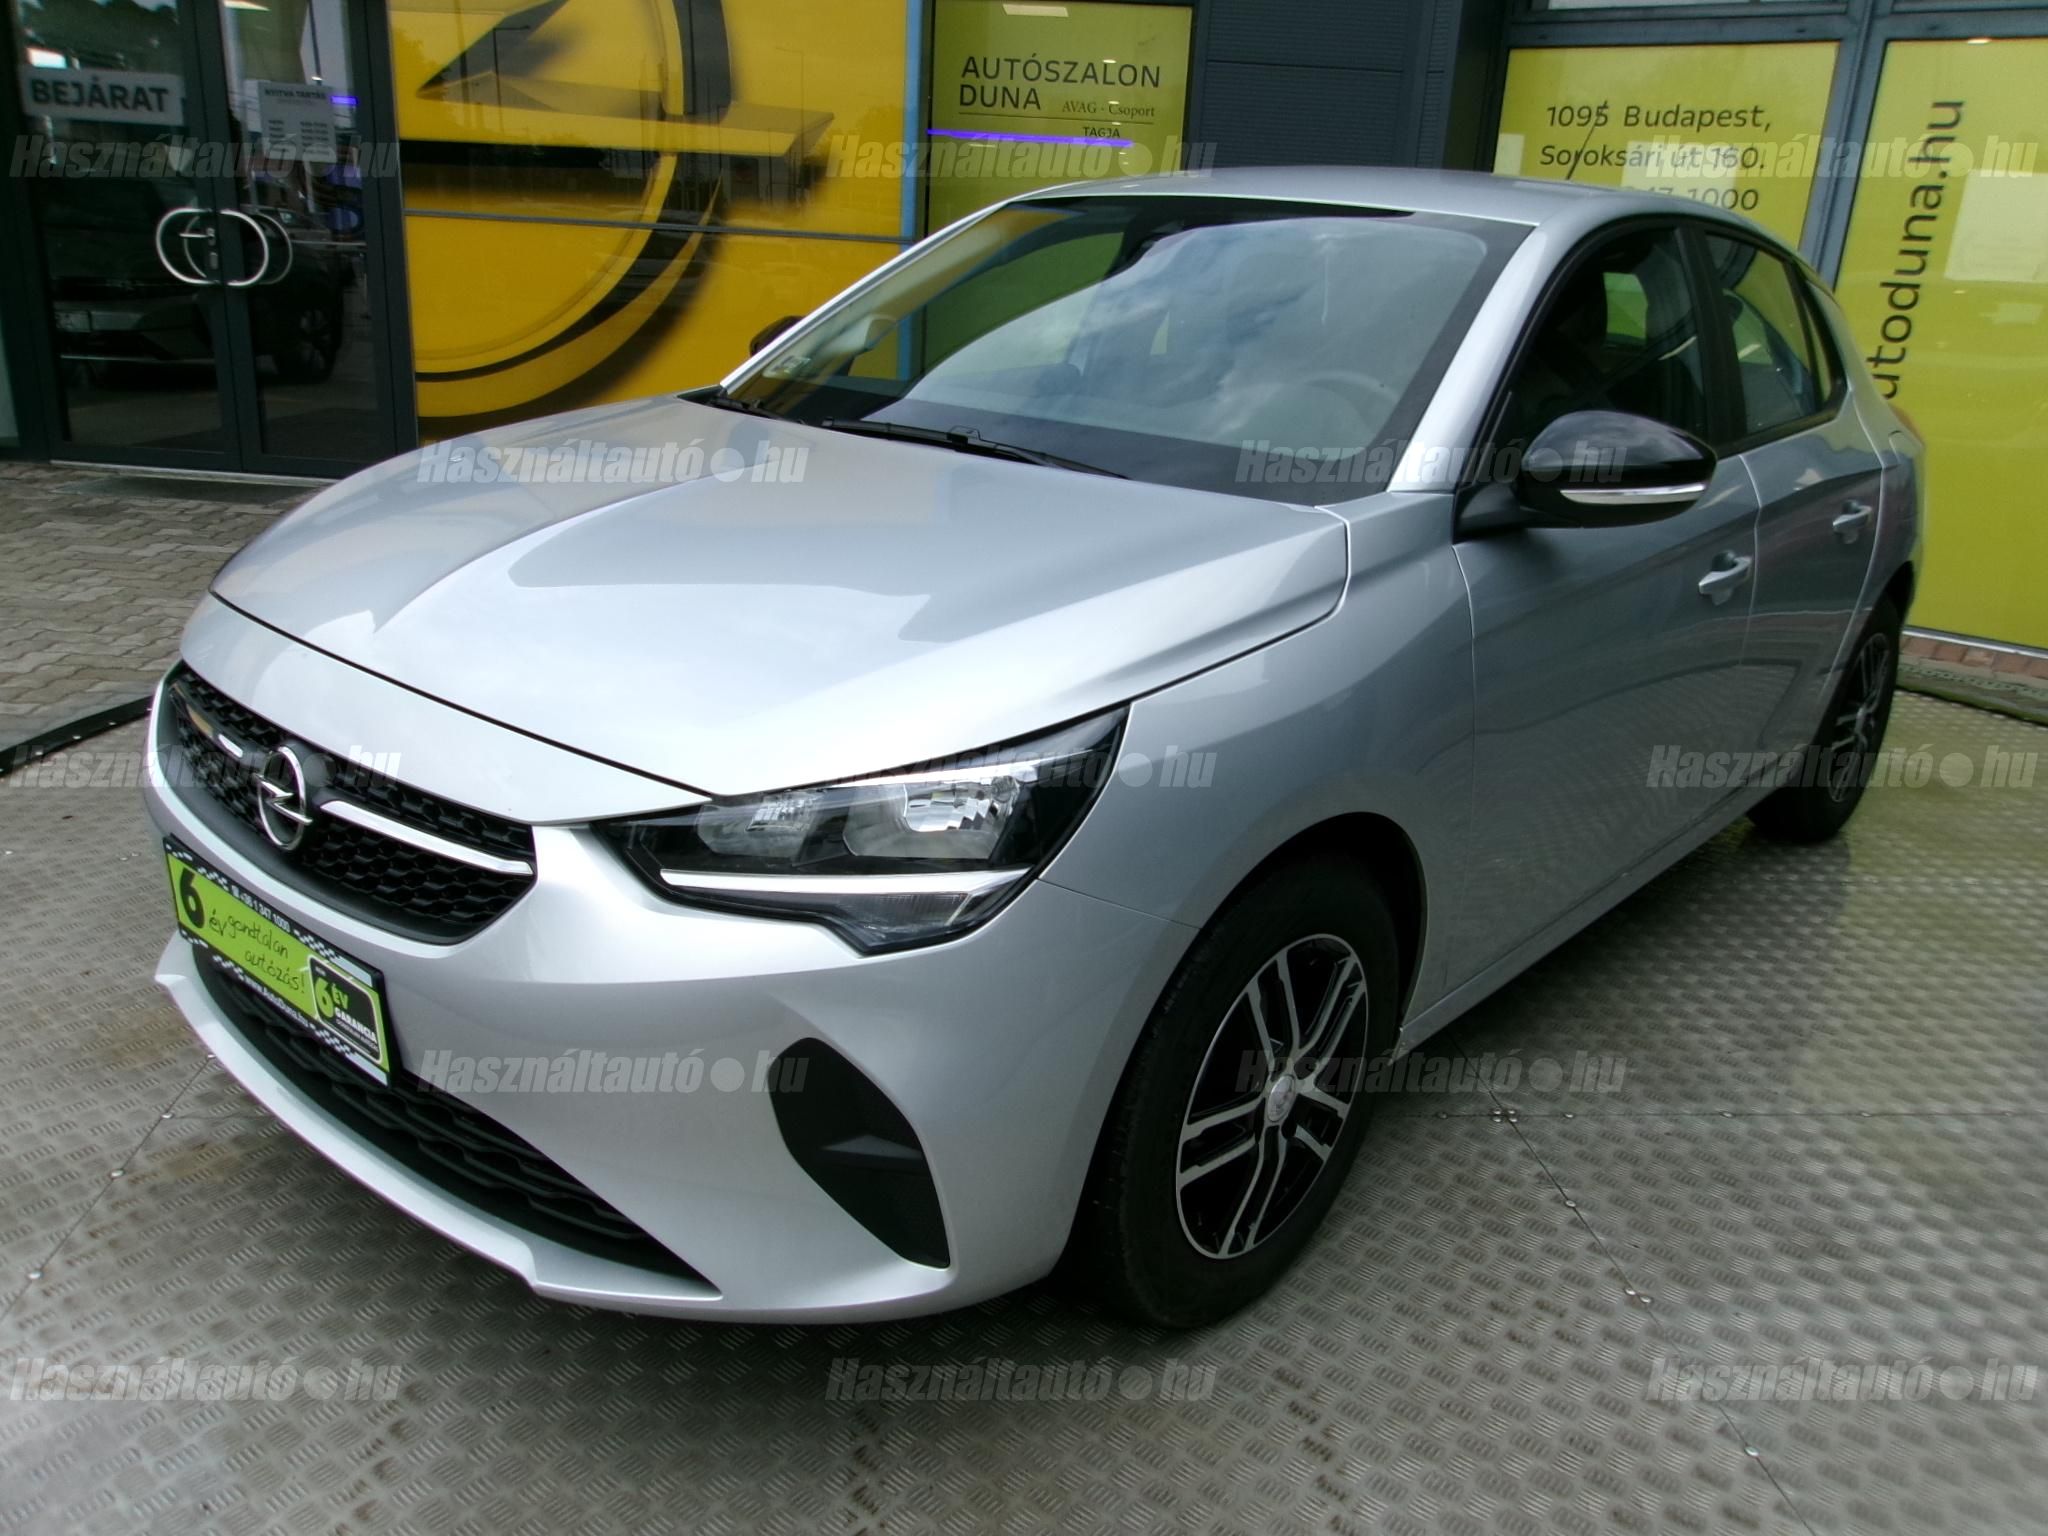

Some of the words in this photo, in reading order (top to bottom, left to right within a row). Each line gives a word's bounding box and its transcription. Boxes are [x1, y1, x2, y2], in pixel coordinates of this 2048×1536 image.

[961, 53, 1161, 88] AUTÓSZALON
[31, 76, 169, 114] BEJÁRAT
[959, 84, 1041, 110] DUNA
[1062, 101, 1097, 114] AVAG
[1108, 102, 1156, 119] Csoport
[1083, 126, 1121, 138] TAGJA
[1547, 104, 1609, 127] 1095
[1624, 104, 1771, 133] Budapest,
[1540, 140, 1662, 168] Soroksári
[1671, 143, 1701, 168] út
[1712, 146, 1765, 169] 160.
[179, 867, 205, 929] 6
[315, 977, 334, 1018] 6
[331, 982, 348, 1010] ÉV
[335, 1006, 378, 1044] GARANCIA
